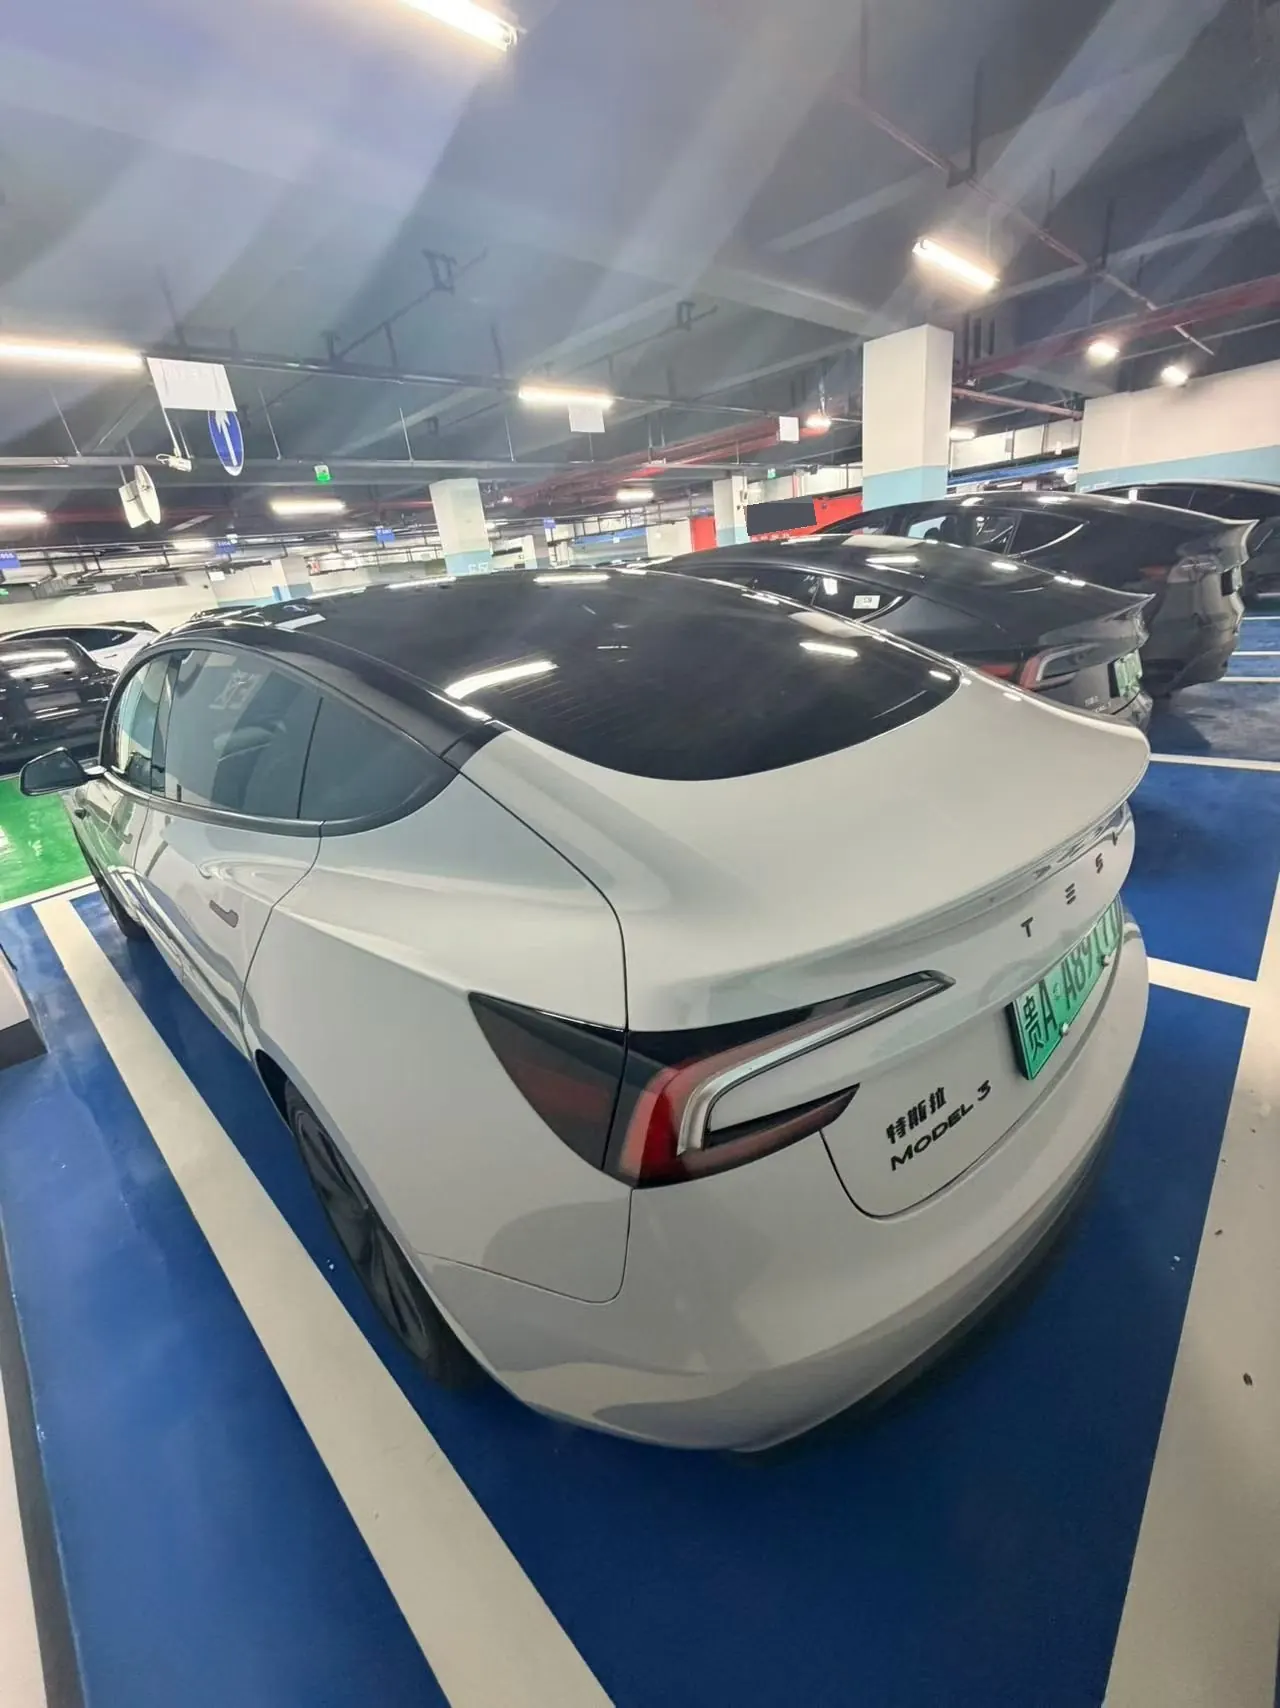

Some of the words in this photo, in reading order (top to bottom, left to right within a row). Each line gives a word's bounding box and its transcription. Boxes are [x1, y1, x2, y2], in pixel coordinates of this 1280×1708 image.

[886, 1087, 947, 1144] 特斯拉
[890, 1104, 974, 1171] MODEL
[977, 1079, 991, 1101] 3
